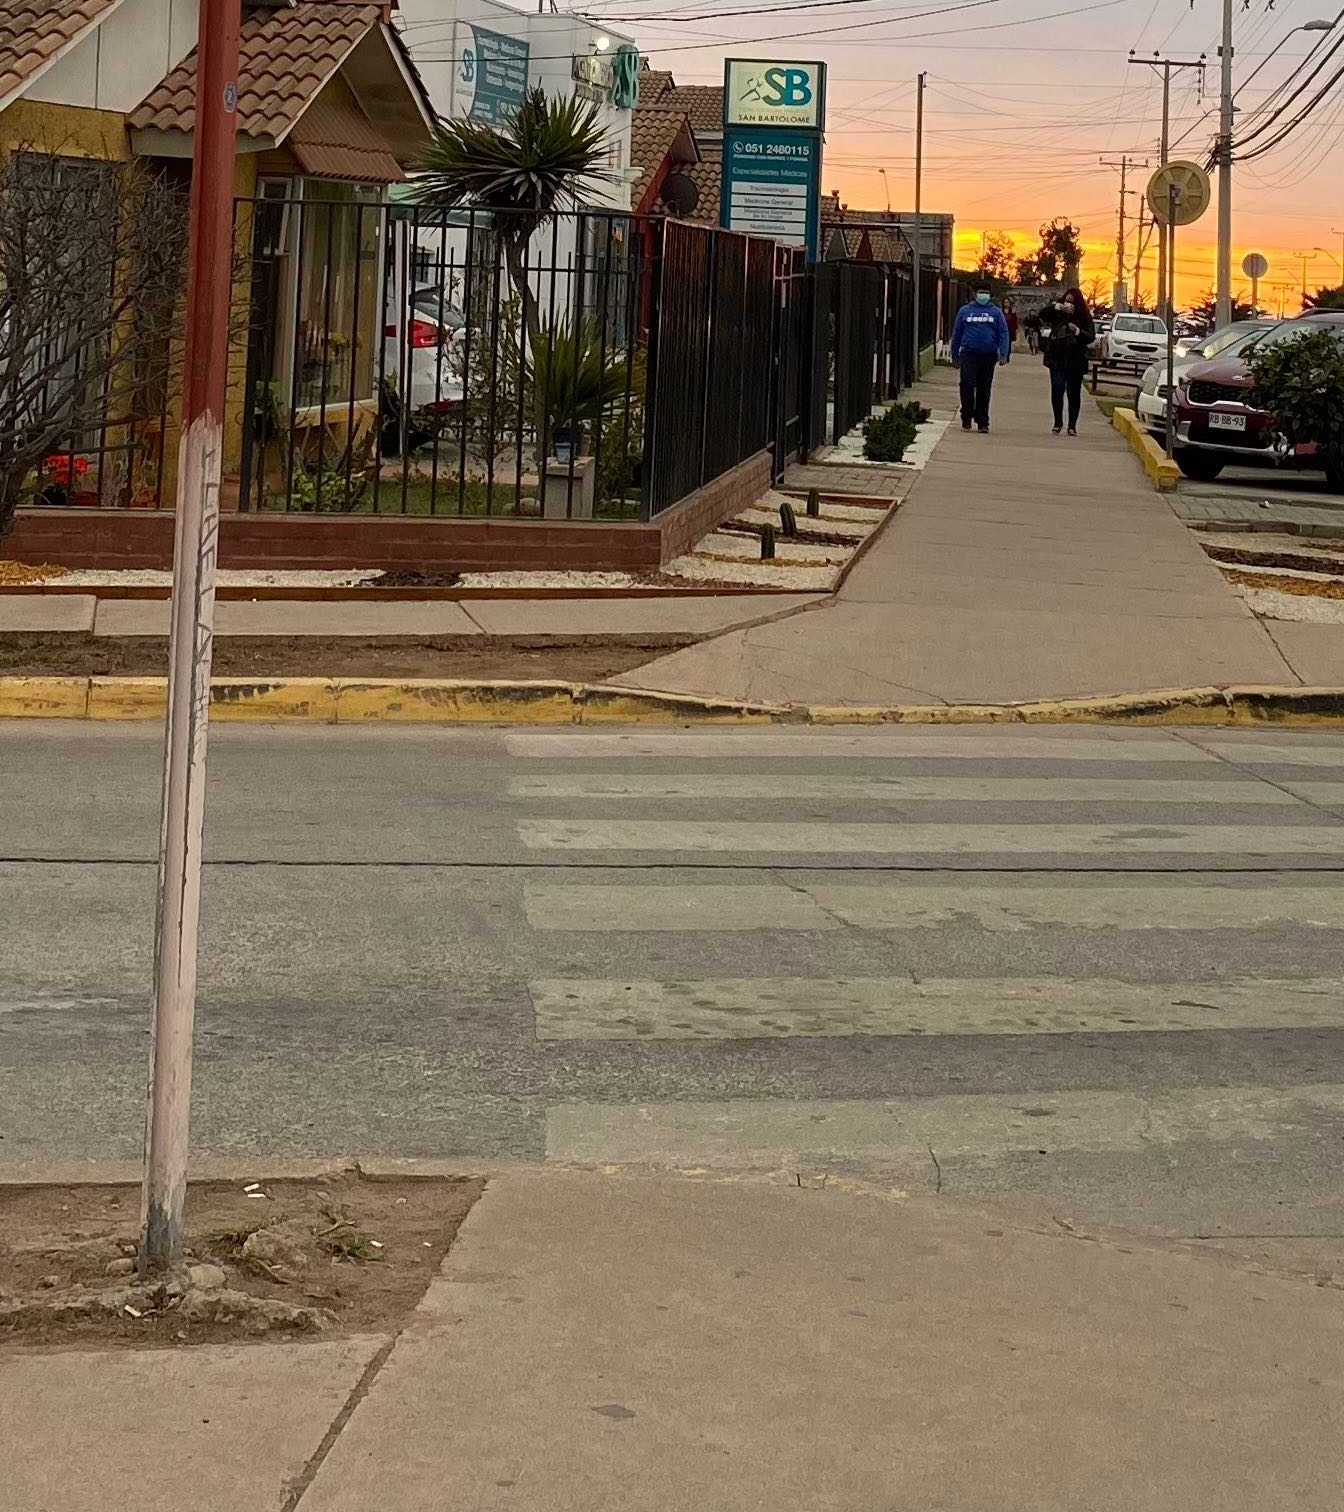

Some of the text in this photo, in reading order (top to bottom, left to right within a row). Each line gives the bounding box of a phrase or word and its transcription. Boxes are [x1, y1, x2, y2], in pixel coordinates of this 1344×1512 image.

[762, 68, 812, 106] SB
[739, 114, 810, 123] SAN BARTOLOME
[745, 143, 810, 155] 051 2480115
